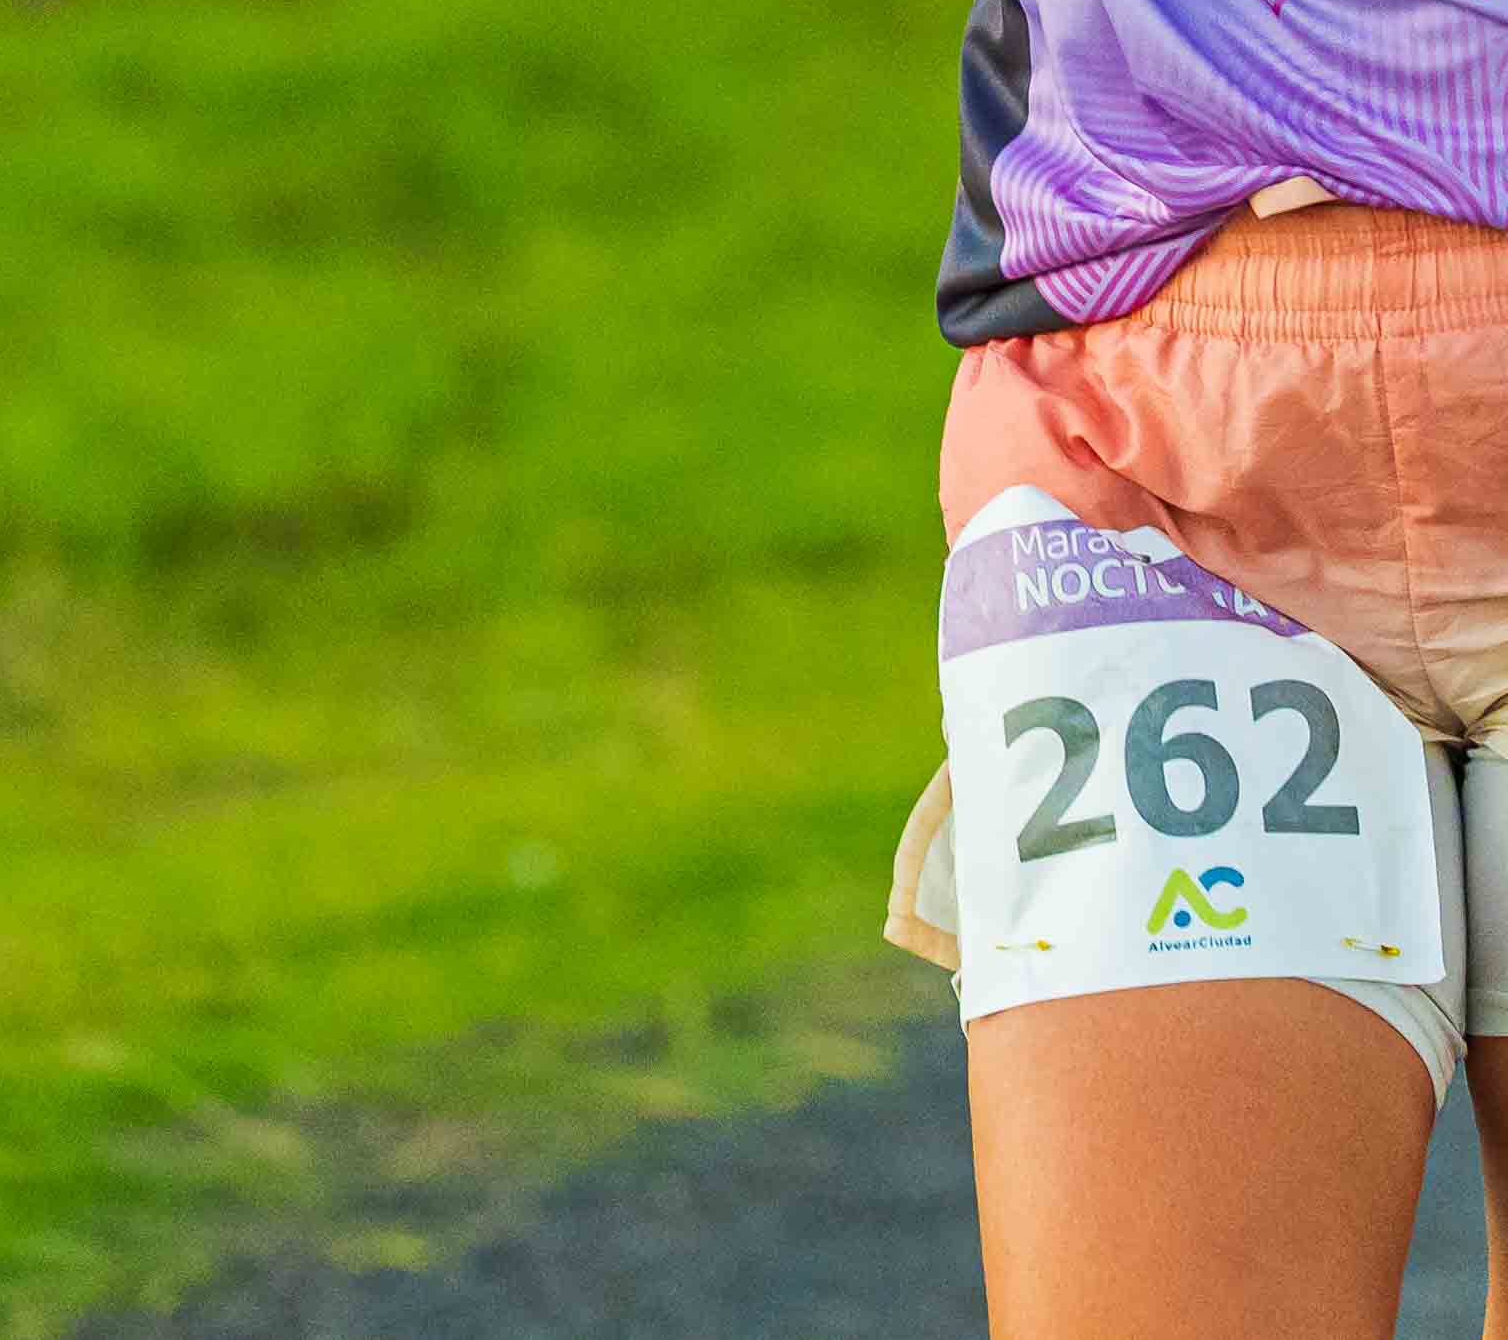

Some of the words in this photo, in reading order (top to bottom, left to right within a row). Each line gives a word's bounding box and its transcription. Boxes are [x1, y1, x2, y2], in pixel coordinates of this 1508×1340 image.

[1011, 525, 1120, 563] Mara
[1002, 679, 1360, 863] 262
[1148, 934, 1252, 952] AlvearCiudad
